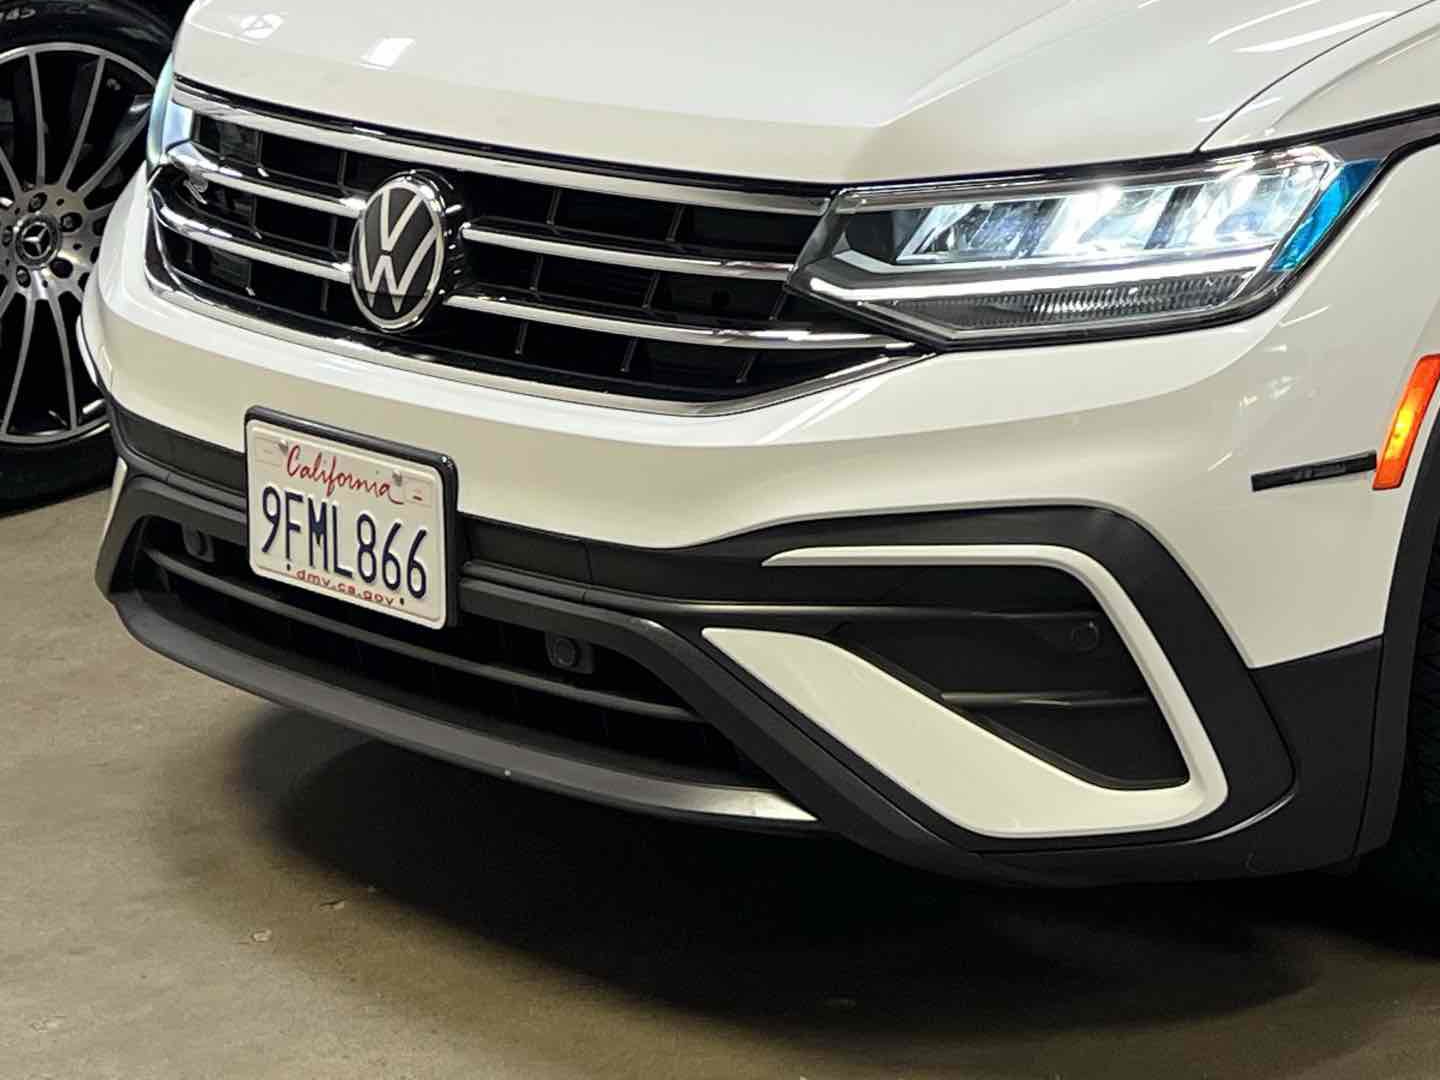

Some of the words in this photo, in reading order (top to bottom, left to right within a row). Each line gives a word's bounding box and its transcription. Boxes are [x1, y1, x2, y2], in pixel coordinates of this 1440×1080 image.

[356, 182, 440, 314] VW
[286, 444, 404, 505] California
[261, 485, 428, 600] 9FML866
[295, 569, 394, 607] dmv.ca.gov
